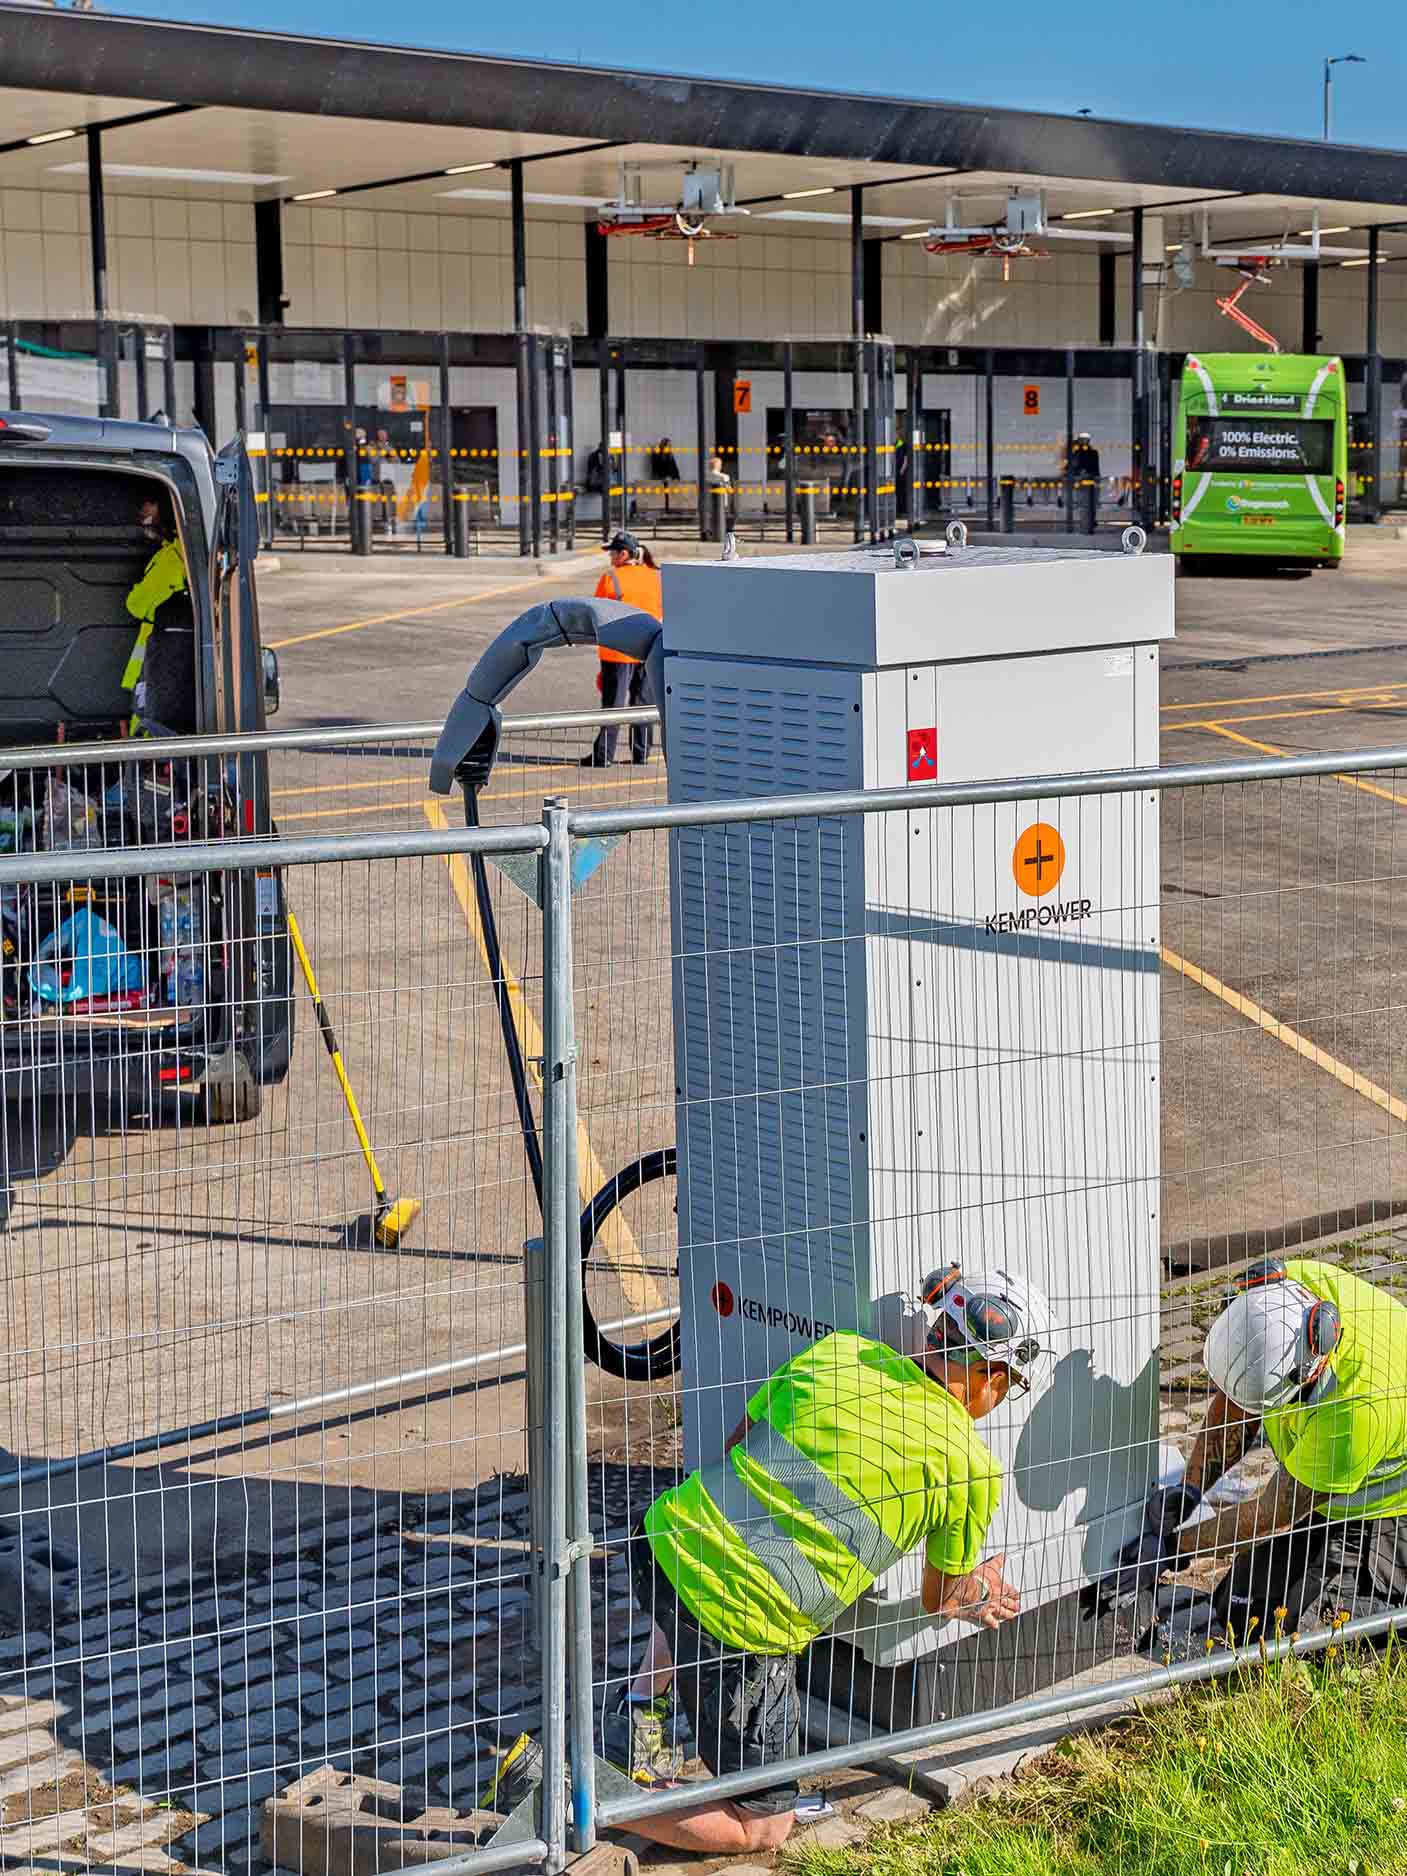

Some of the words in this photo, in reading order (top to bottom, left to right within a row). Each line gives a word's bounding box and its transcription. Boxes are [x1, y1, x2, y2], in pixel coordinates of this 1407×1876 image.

[736, 387, 750, 406] 7
[1025, 390, 1038, 408] 8
[1222, 431, 1251, 443] 100%
[1252, 432, 1299, 444] Electric.
[1219, 446, 1237, 457] 0%
[1238, 446, 1300, 459] Emissions.
[984, 898, 1093, 937] KEMPOWER
